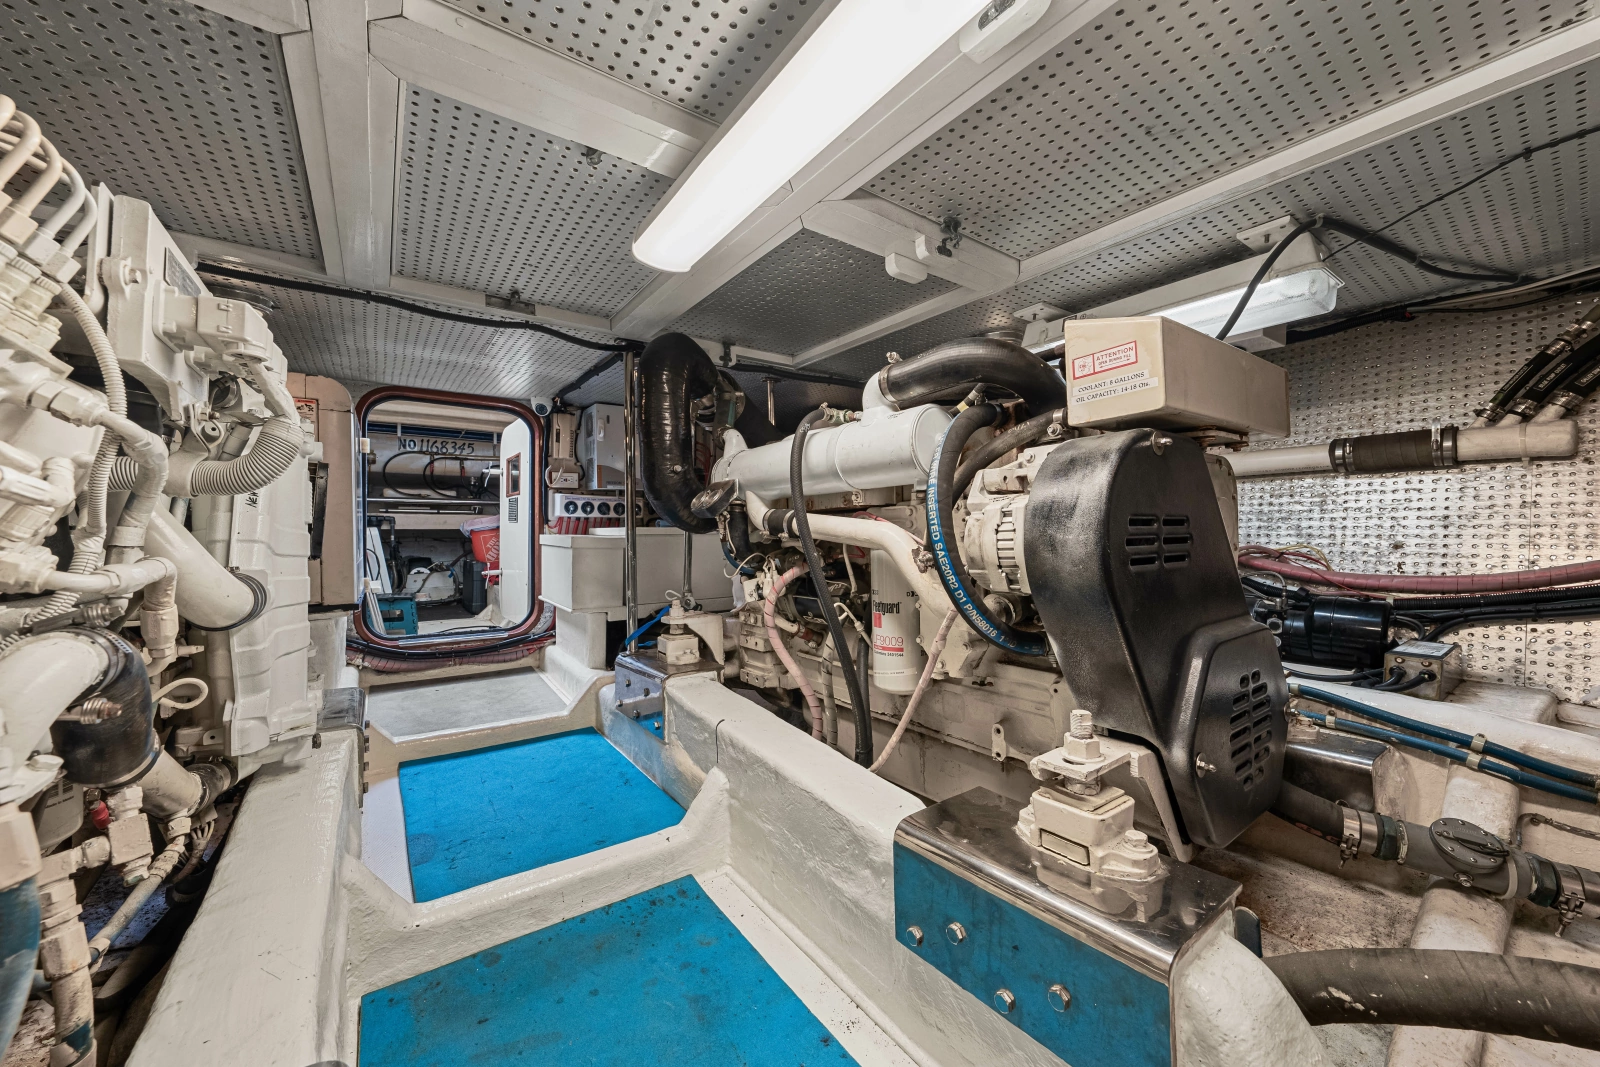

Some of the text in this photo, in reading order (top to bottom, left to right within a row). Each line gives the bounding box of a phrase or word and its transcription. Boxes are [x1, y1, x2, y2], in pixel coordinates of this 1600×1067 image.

[1096, 346, 1134, 361] ATTENTION
[1114, 371, 1145, 384] GALLONS
[927, 487, 941, 541] INSERTED
[934, 542, 959, 590] SAE20R2
[954, 590, 967, 604] D1
[963, 603, 998, 637] P/N58016
